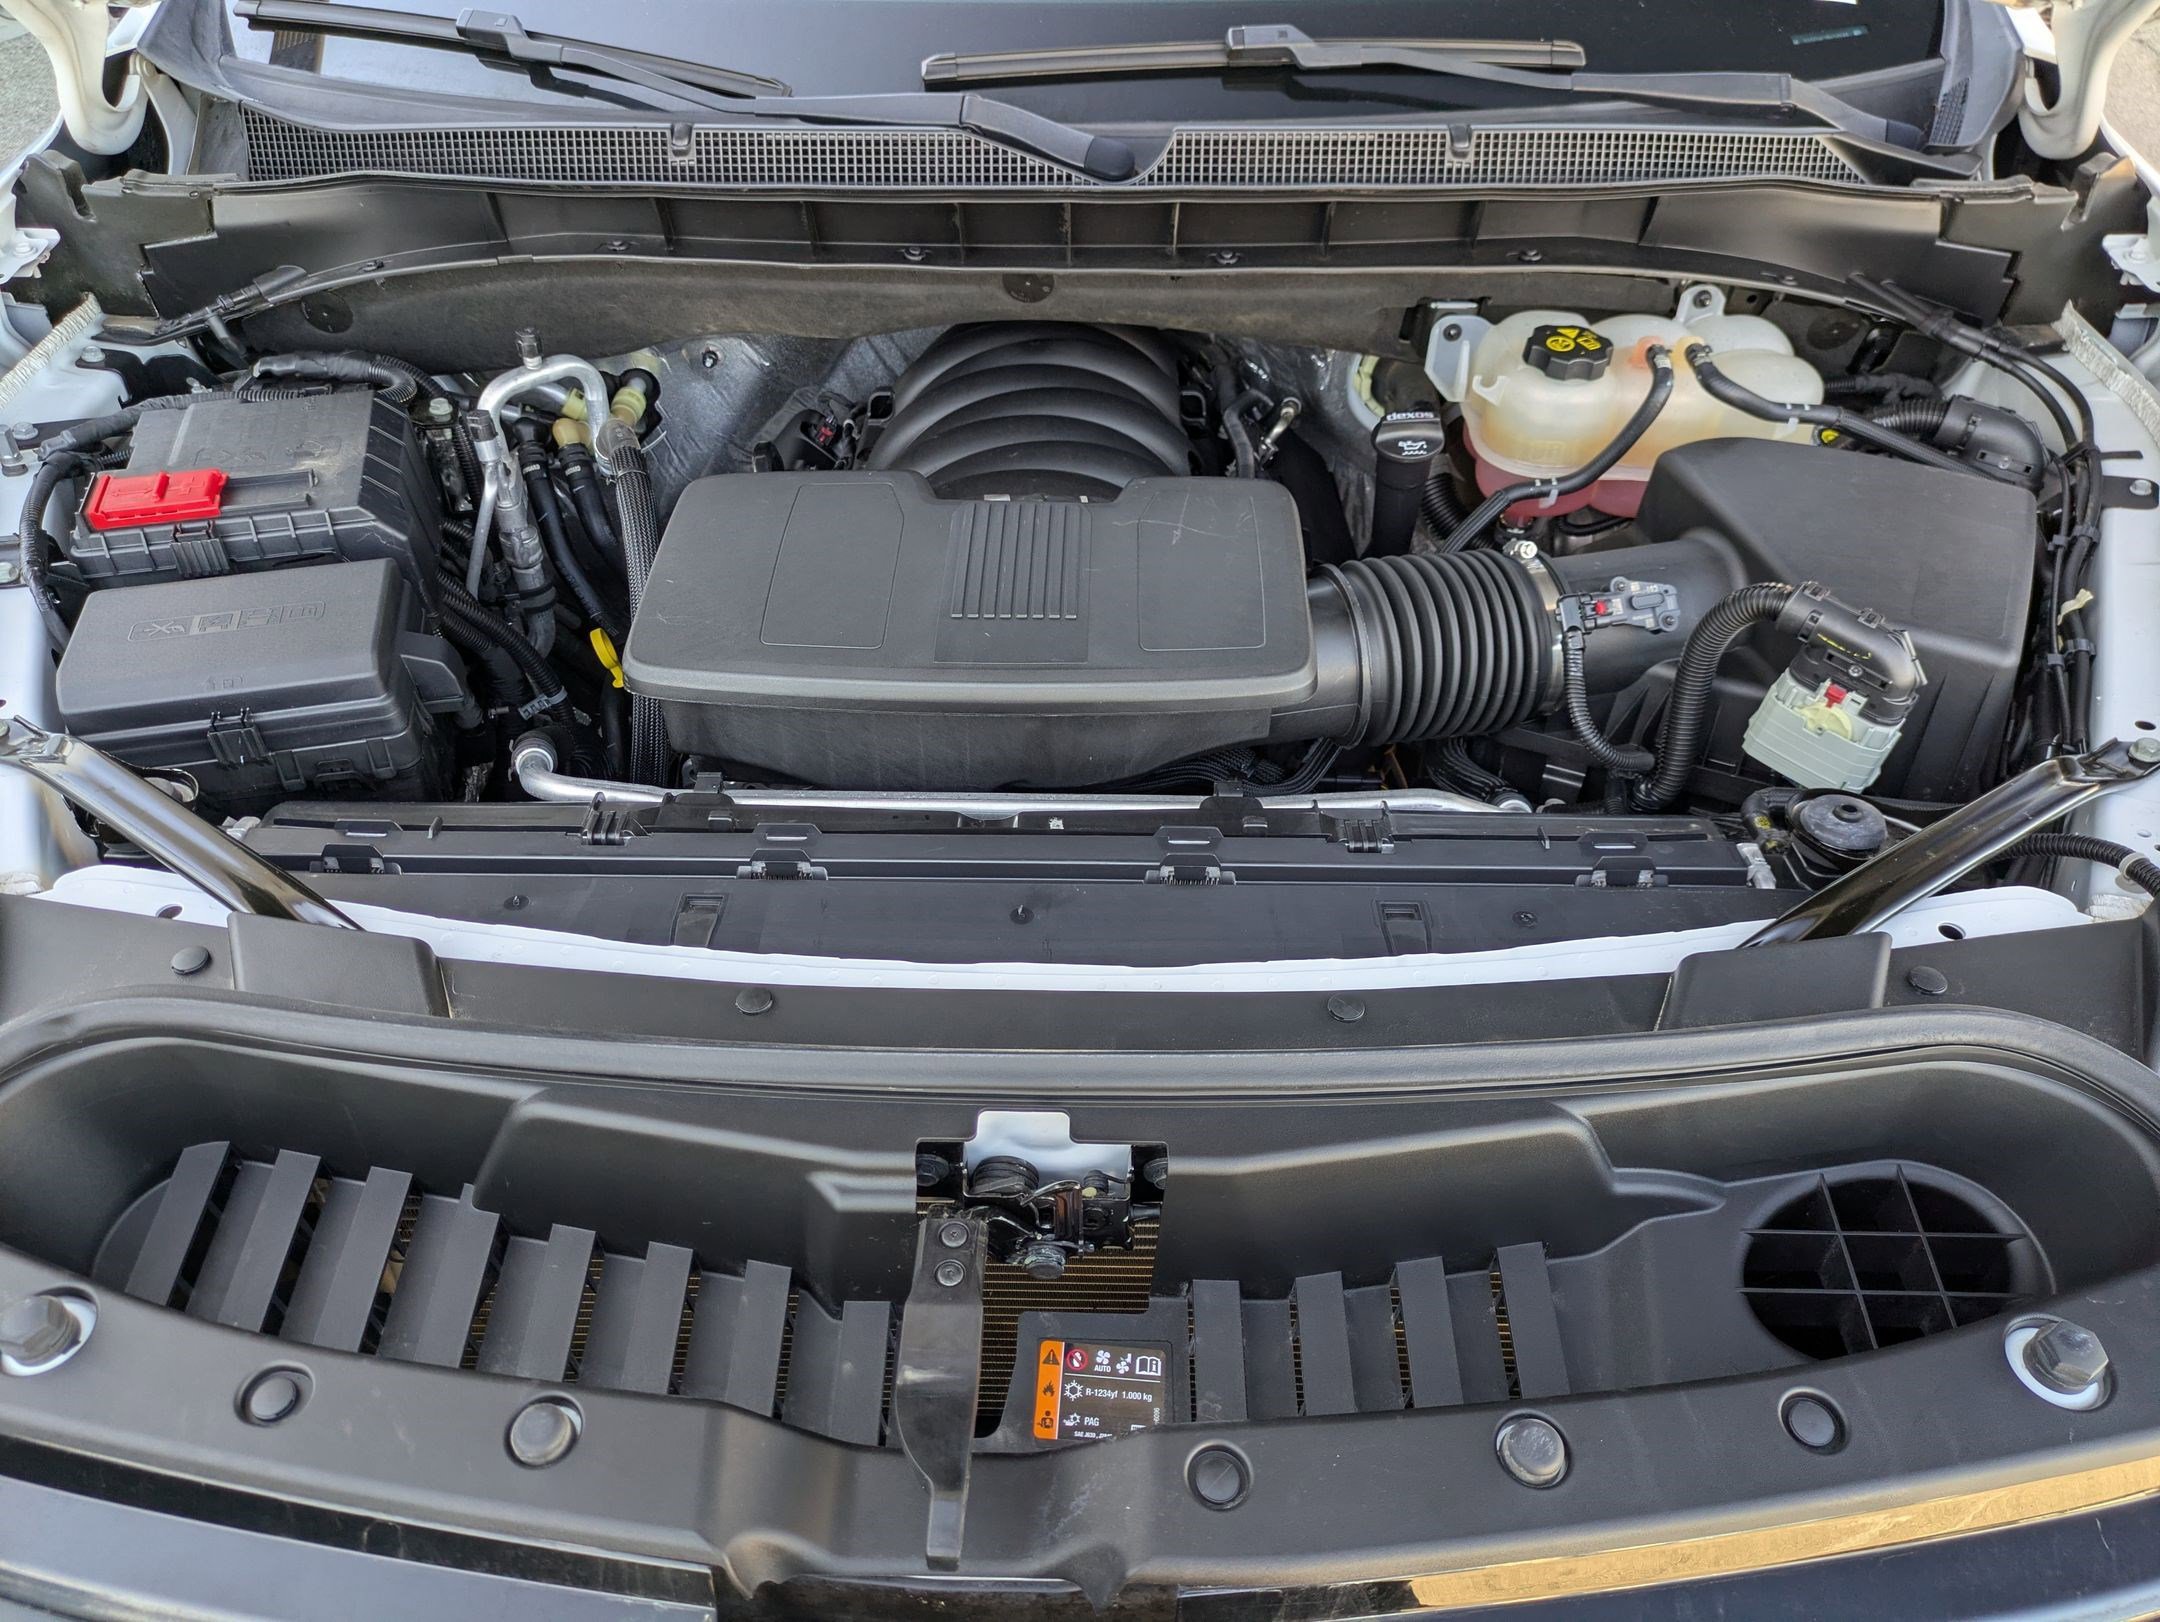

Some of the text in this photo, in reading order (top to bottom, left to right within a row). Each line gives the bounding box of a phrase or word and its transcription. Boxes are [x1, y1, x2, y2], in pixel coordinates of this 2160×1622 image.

[1386, 411, 1434, 421] dexos
[1094, 1364, 1112, 1373] AUTO
[1085, 1387, 1153, 1403] R-1234yf 1.000 kg
[1084, 1416, 1100, 1427] PAG
